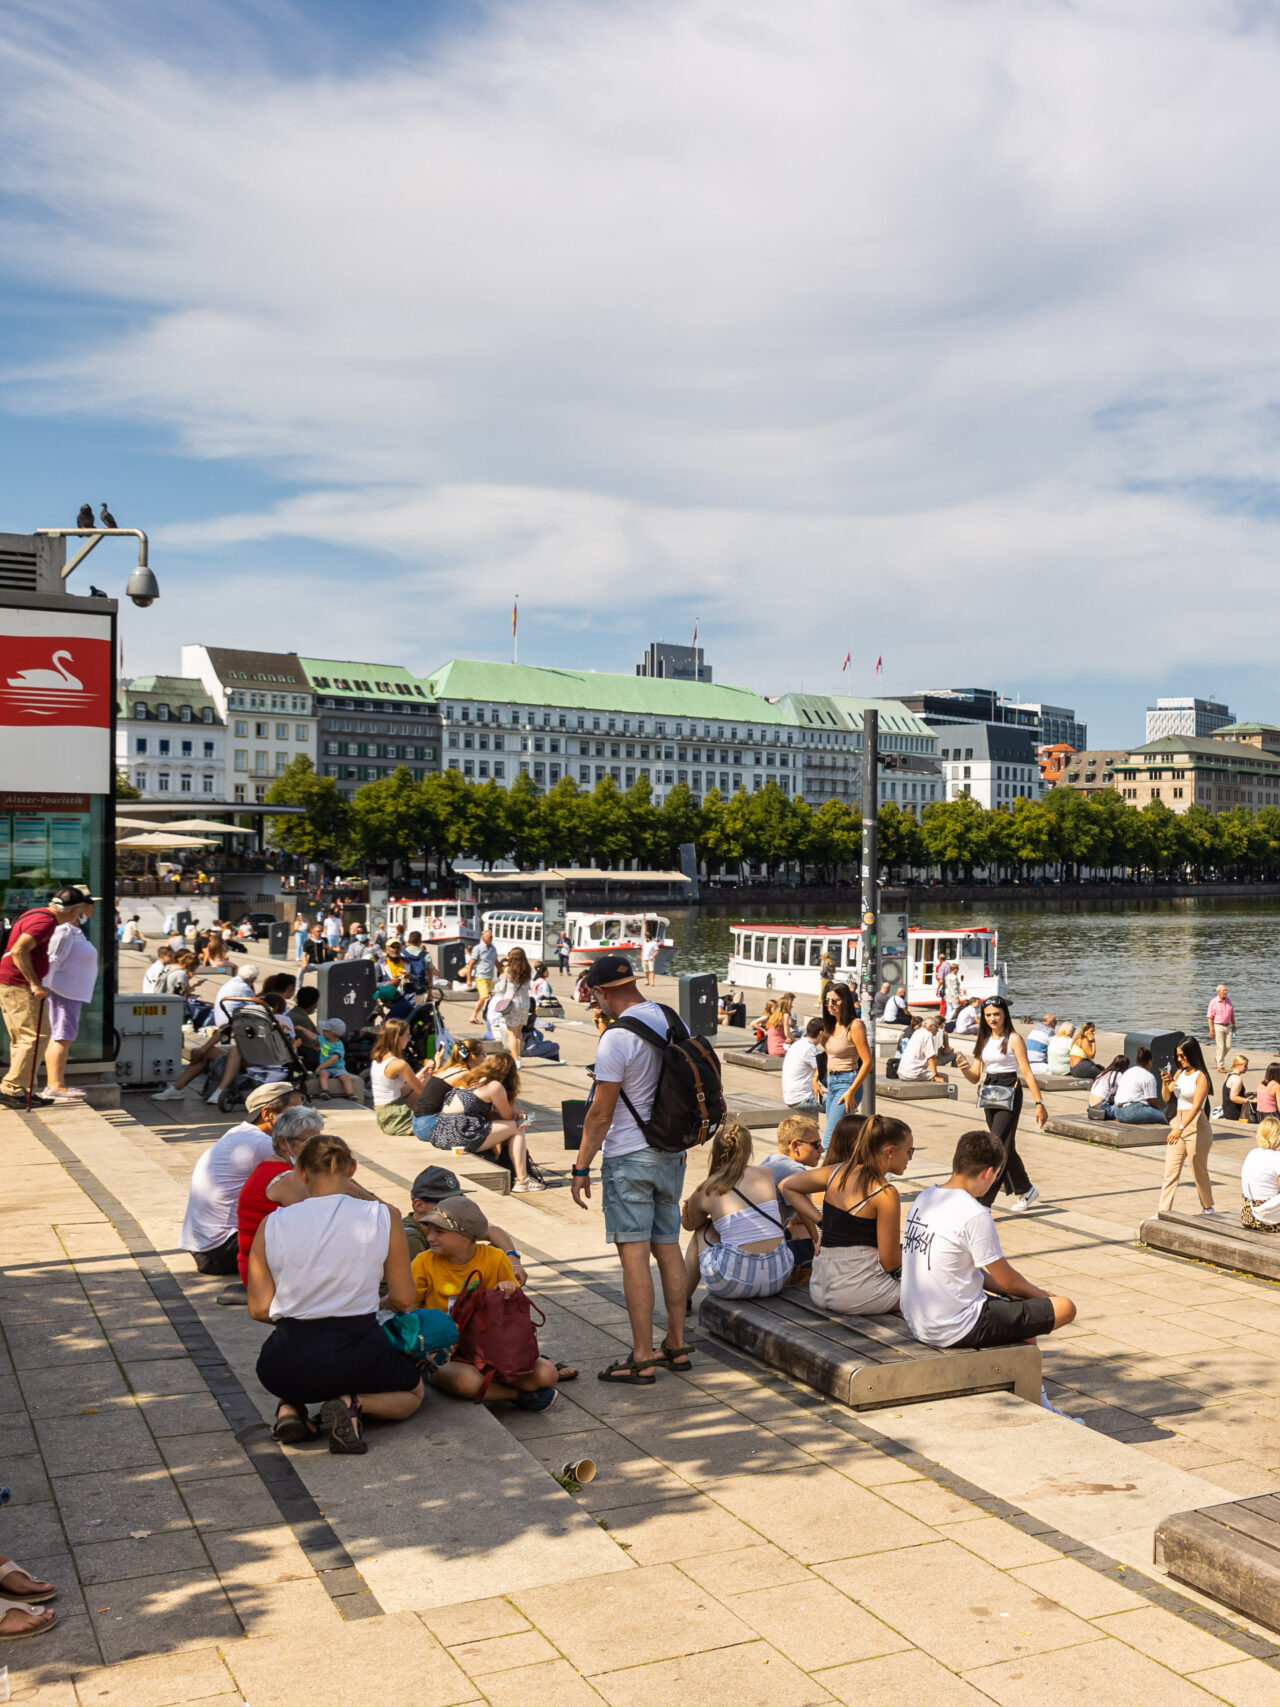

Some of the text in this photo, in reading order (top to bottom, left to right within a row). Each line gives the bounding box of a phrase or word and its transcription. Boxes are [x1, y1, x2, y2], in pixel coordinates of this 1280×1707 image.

[4, 795, 83, 805] Alster-Touristik
[558, 909, 565, 918] 5
[897, 928, 906, 941] 4
